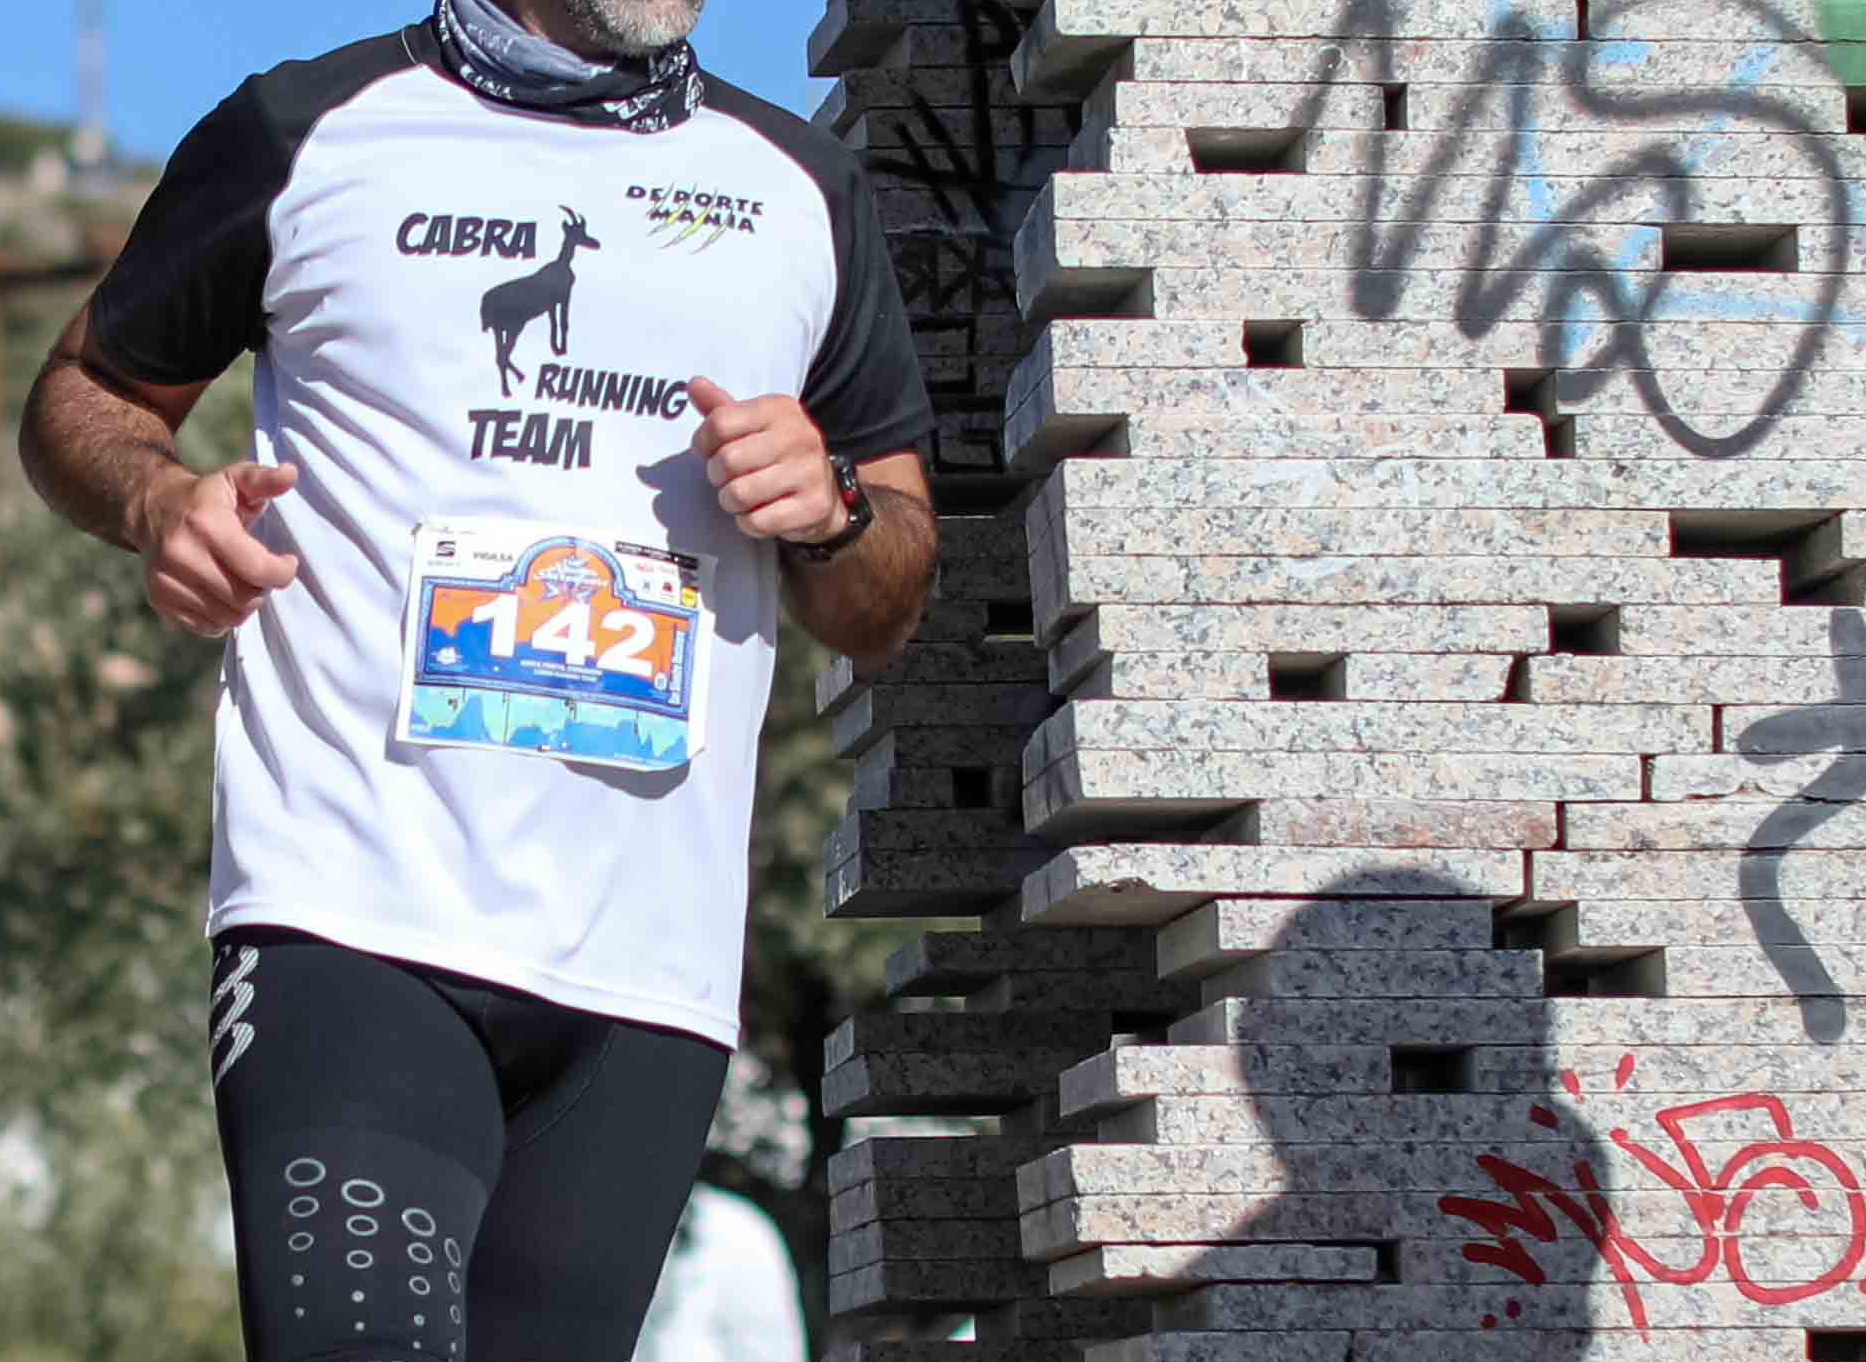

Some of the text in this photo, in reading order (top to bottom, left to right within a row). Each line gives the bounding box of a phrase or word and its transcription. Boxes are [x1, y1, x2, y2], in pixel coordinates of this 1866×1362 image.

[396, 212, 537, 260] CABRA
[646, 209, 756, 233] MANIA
[535, 363, 687, 420] RUNNING
[468, 409, 593, 470] TEAM
[471, 594, 656, 679] 142
